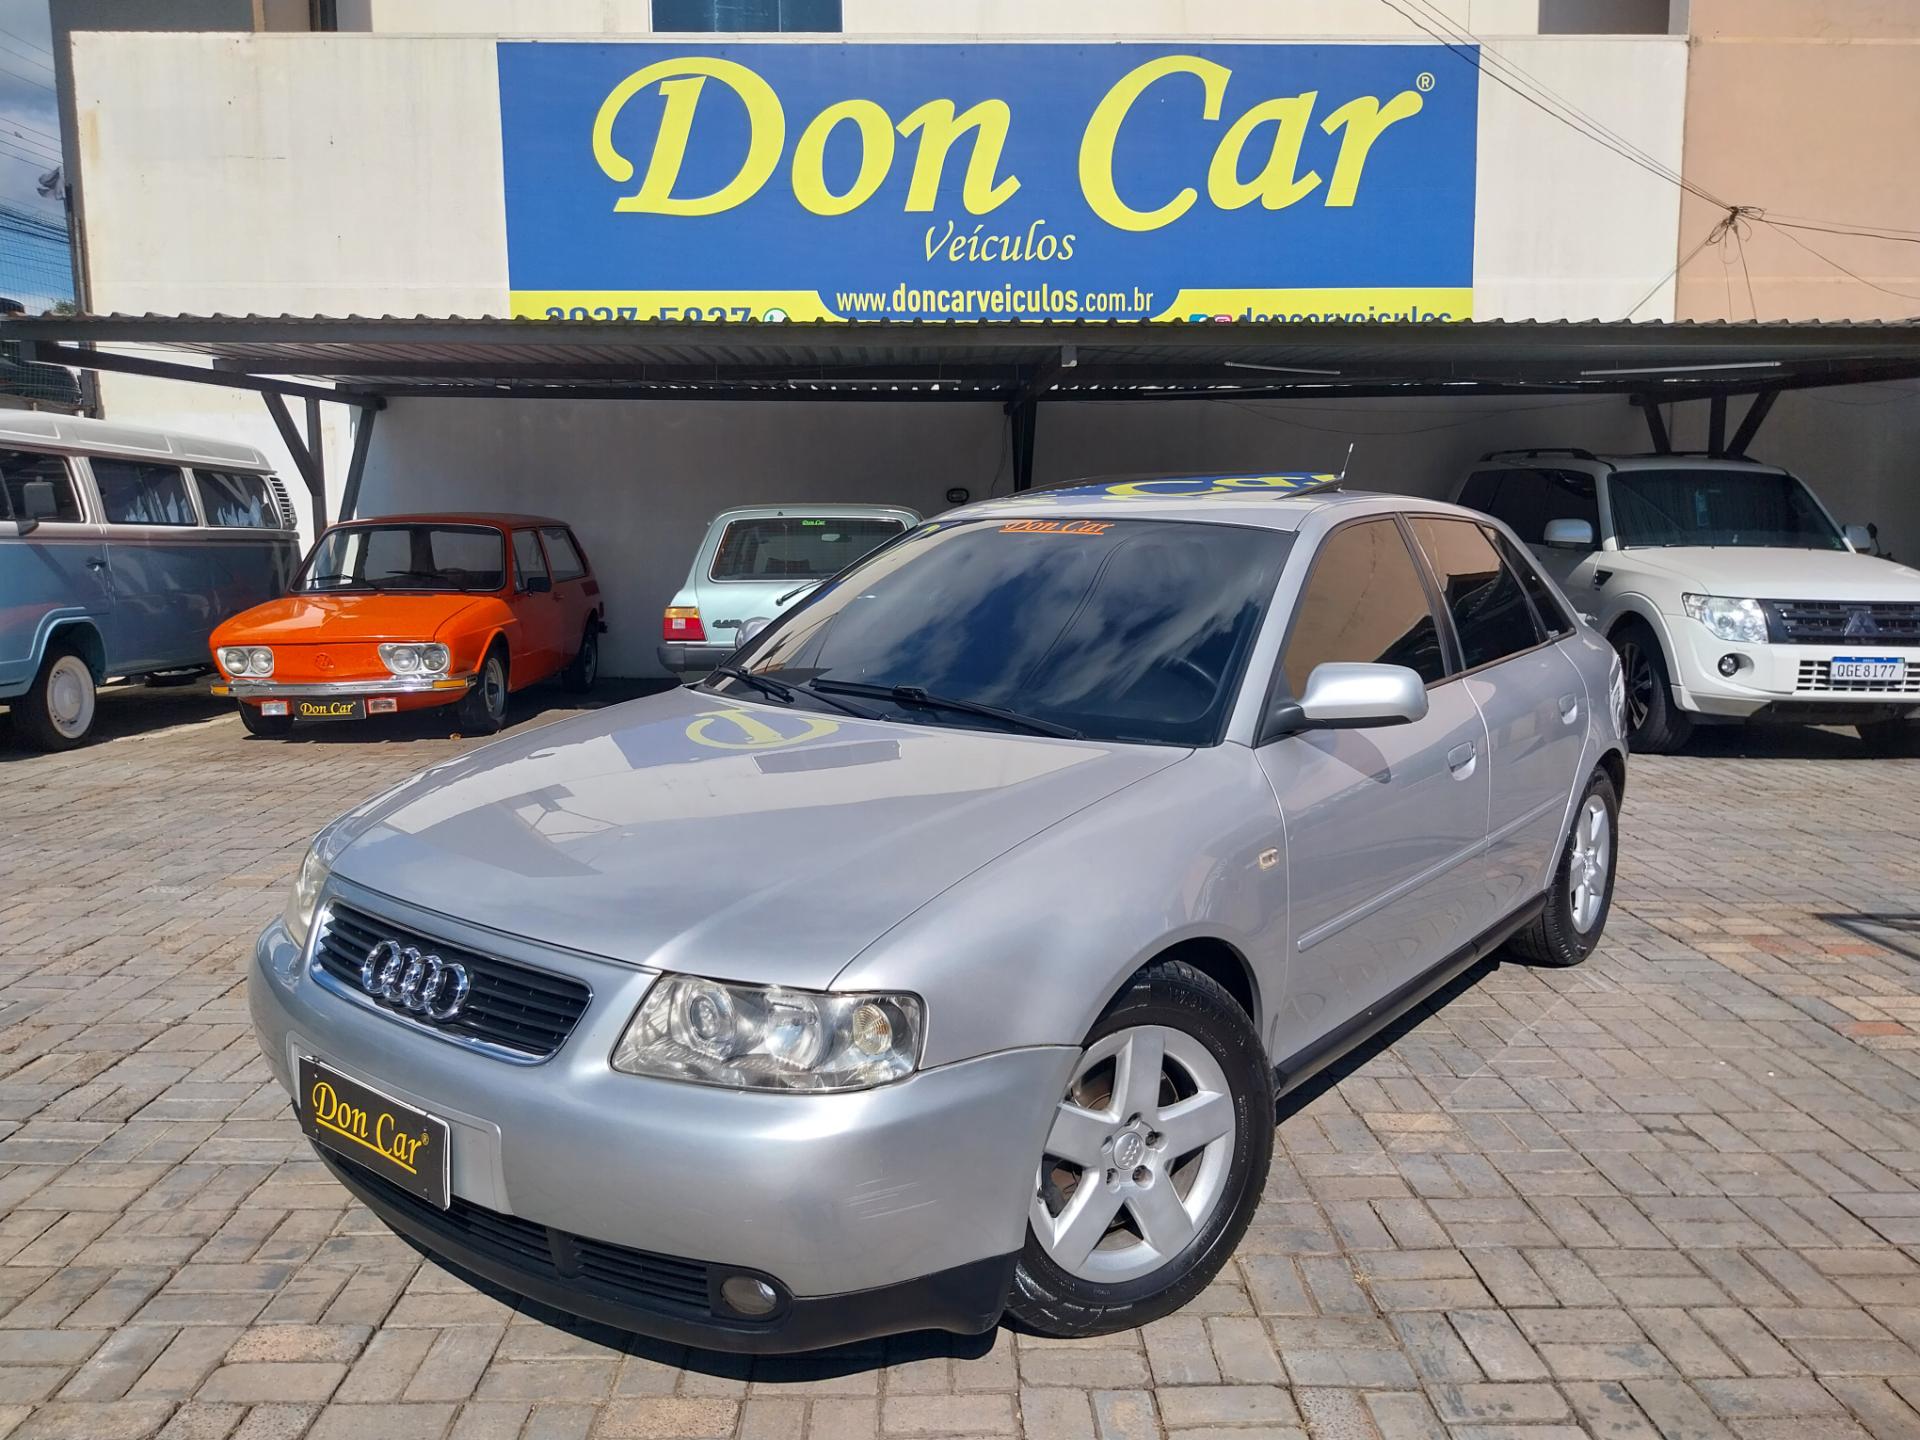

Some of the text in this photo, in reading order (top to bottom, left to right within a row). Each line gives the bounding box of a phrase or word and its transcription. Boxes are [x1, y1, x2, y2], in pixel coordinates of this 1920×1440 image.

[592, 56, 1022, 217] Don
[925, 219, 1076, 262] Veículos
[836, 283, 1154, 313] www.doncarveiculos.com.br
[1005, 519, 1115, 533] Don Car
[1837, 664, 1896, 678] QGE8177
[300, 702, 327, 714] Don
[312, 1081, 369, 1138] Don
